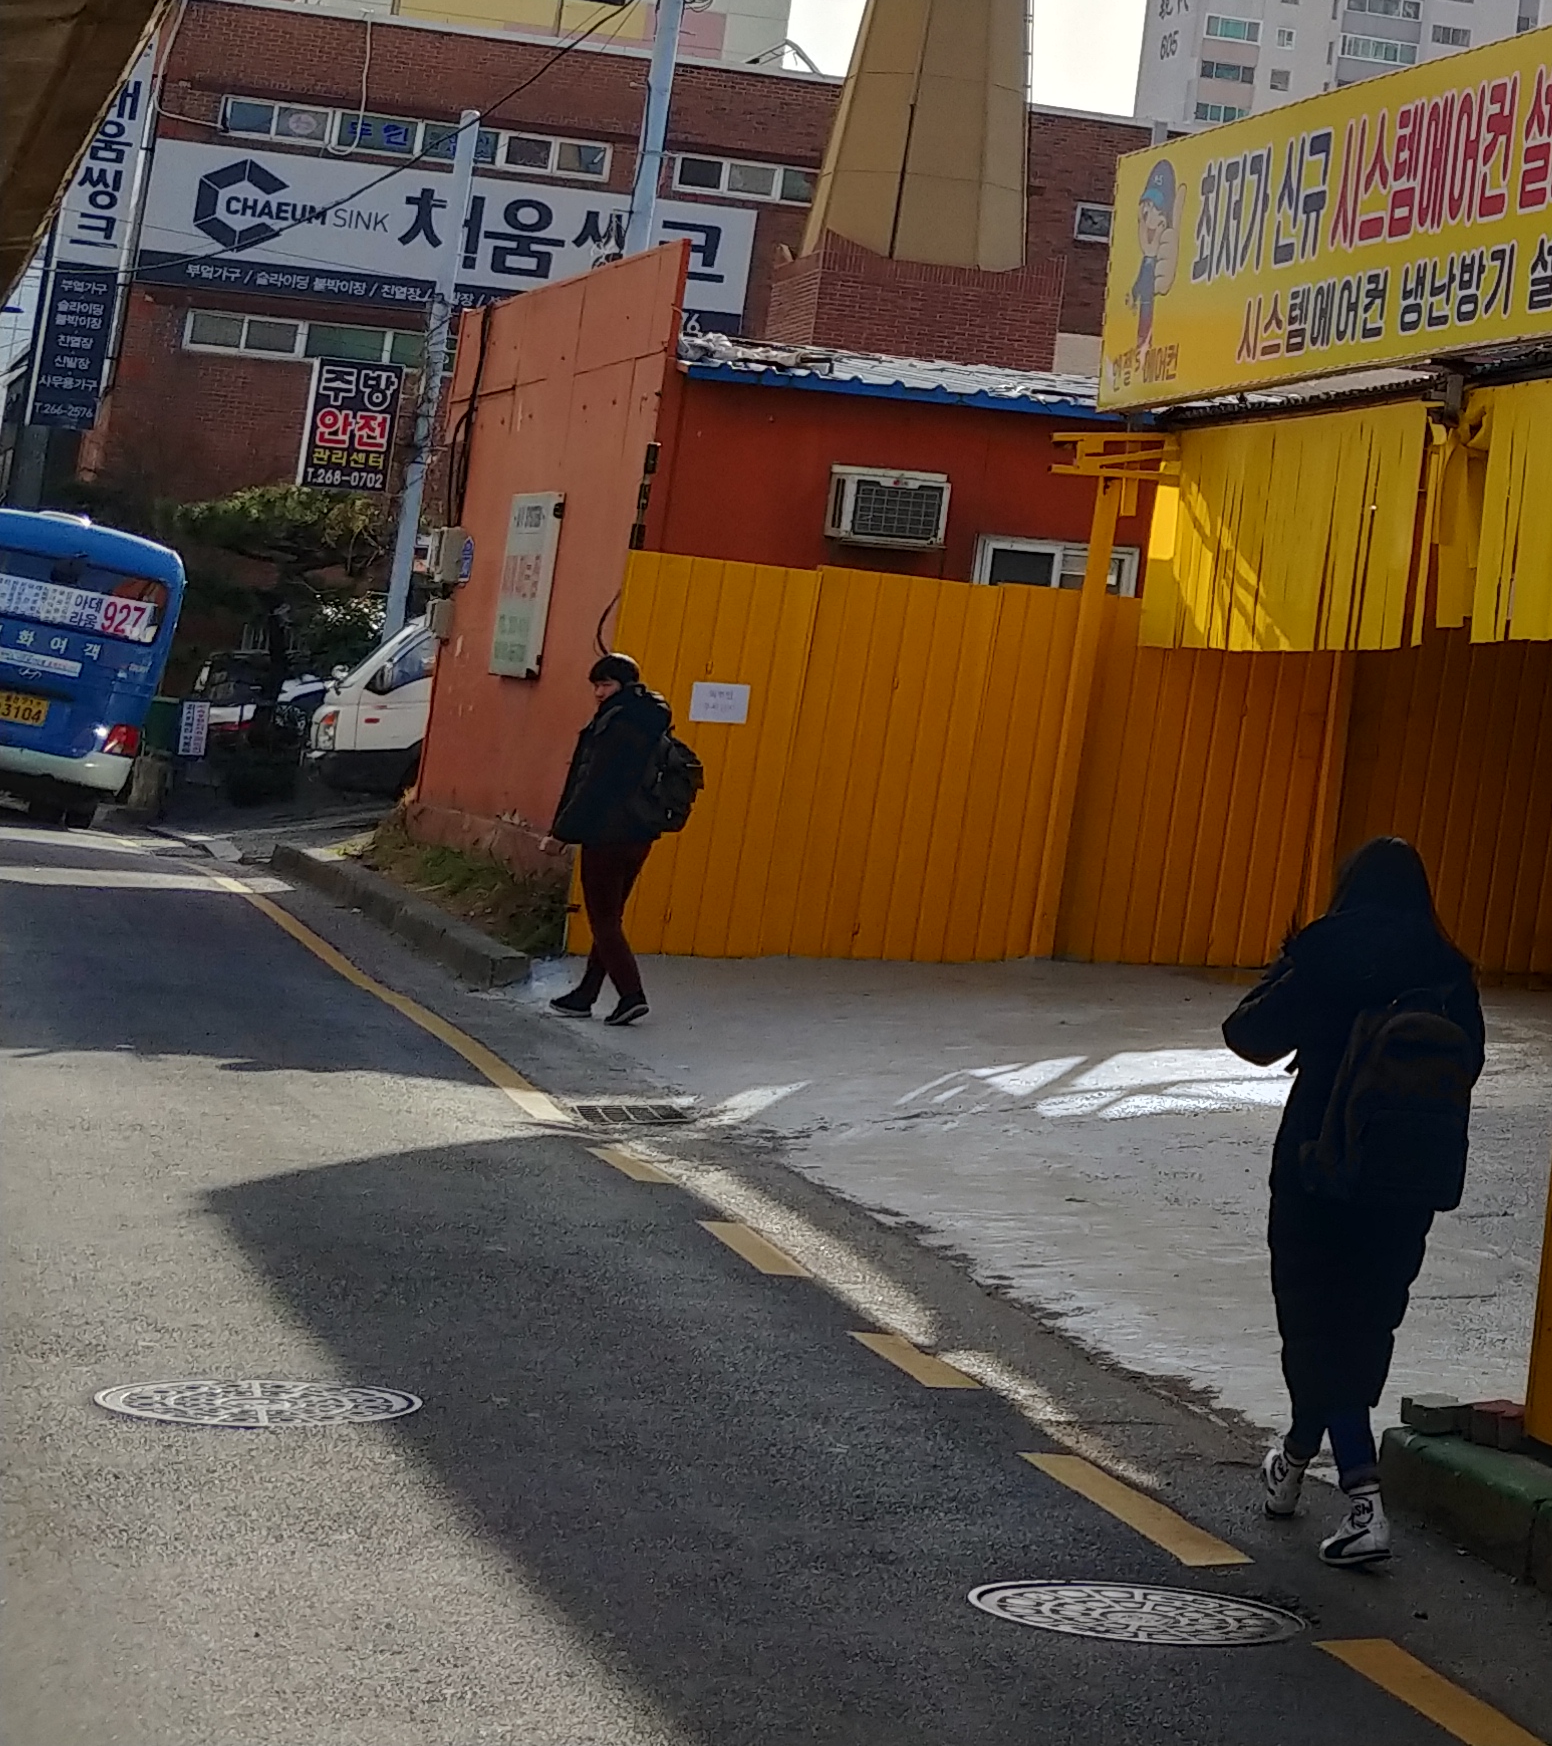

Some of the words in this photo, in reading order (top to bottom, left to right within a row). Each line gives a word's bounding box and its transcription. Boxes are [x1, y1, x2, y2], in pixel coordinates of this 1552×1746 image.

[1191, 142, 1274, 284] 최저가
[1272, 126, 1334, 269] 신규
[1328, 70, 1521, 253] 시스템에어컨
[225, 195, 328, 226] CHAEUM
[332, 208, 390, 234] SINK
[255, 270, 311, 292] 슬라이딩
[312, 276, 369, 298] 붙박이장
[380, 283, 422, 302] 진열장
[1235, 265, 1390, 365] 시스템에어컨
[1398, 238, 1519, 336] 냉난방기
[55, 313, 102, 330] 붙박이장
[56, 299, 104, 316] 슬라이딩
[57, 334, 94, 350] 진열장
[54, 355, 91, 371] 신발장
[38, 374, 99, 393] 사무용가구
[318, 365, 398, 411] 주방
[316, 407, 392, 453] 안전
[311, 448, 385, 470] 관리센터
[101, 601, 146, 636] 927
